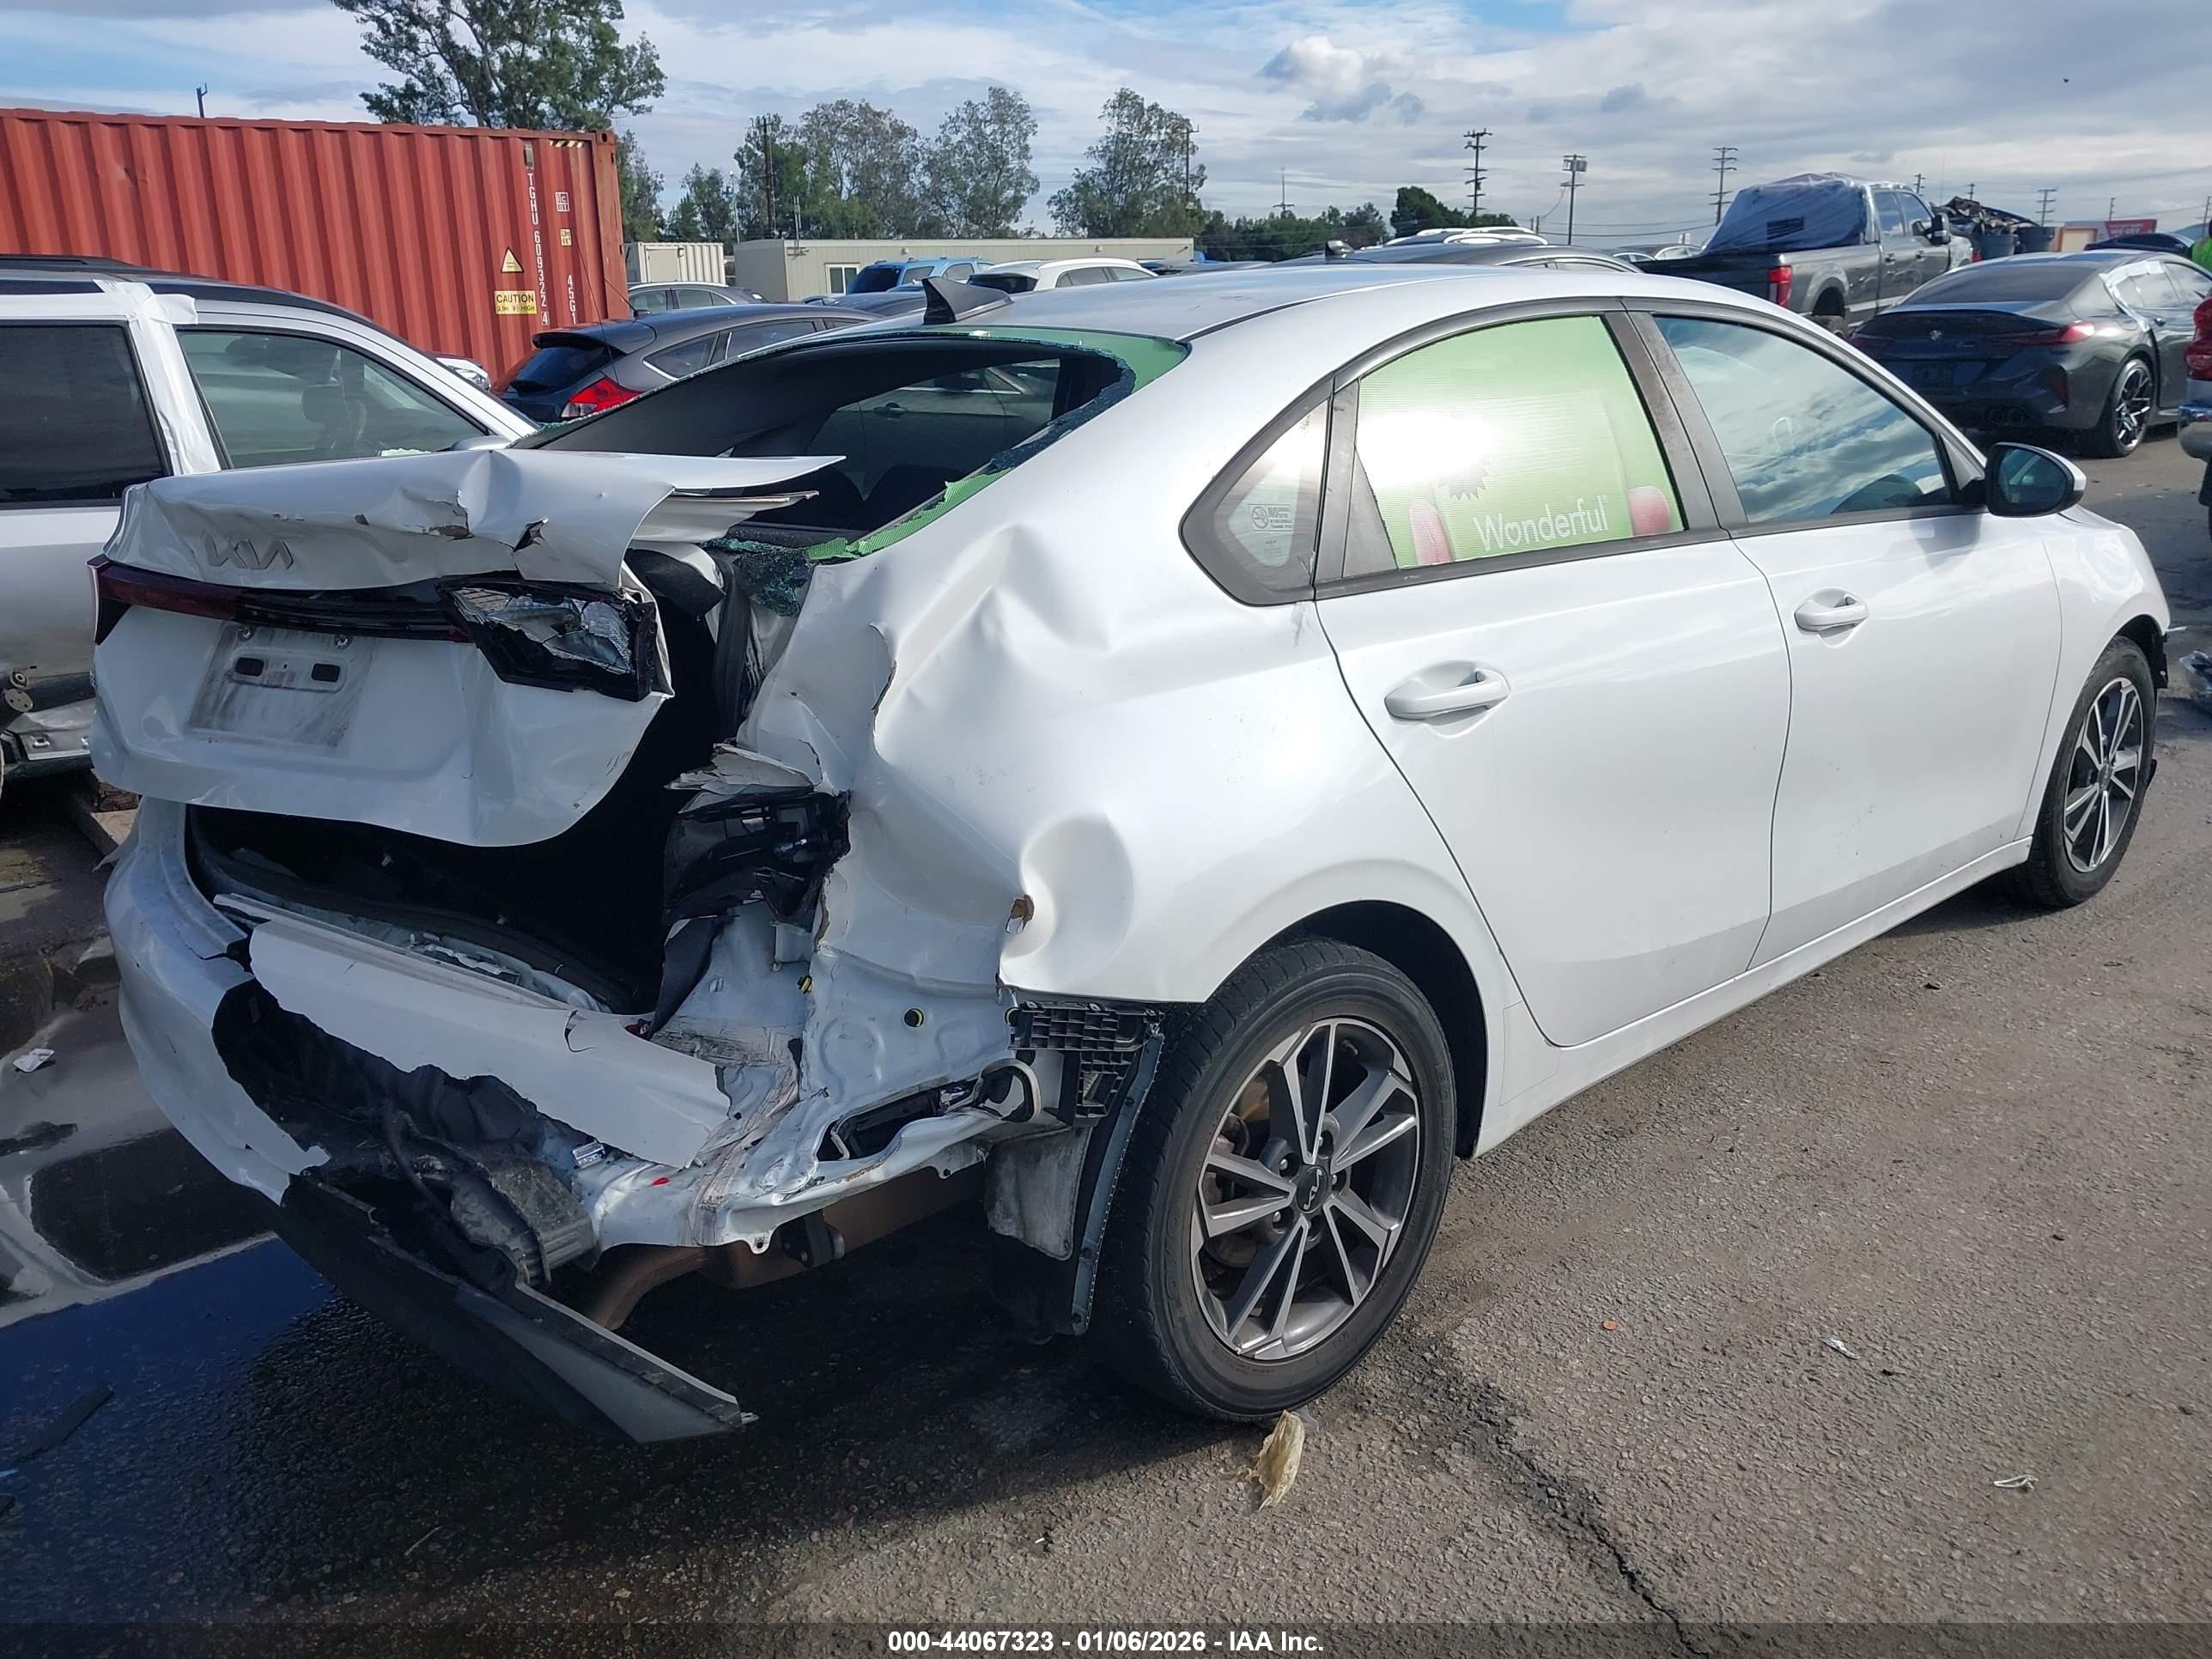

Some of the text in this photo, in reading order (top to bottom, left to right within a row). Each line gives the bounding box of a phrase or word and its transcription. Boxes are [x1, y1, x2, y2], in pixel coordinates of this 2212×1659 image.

[527, 173, 539, 225] TGHU
[534, 230, 547, 307] 609322
[496, 294, 534, 303] CAUTION
[567, 274, 577, 325] 45G1
[1473, 495, 1608, 551] Wonderful
